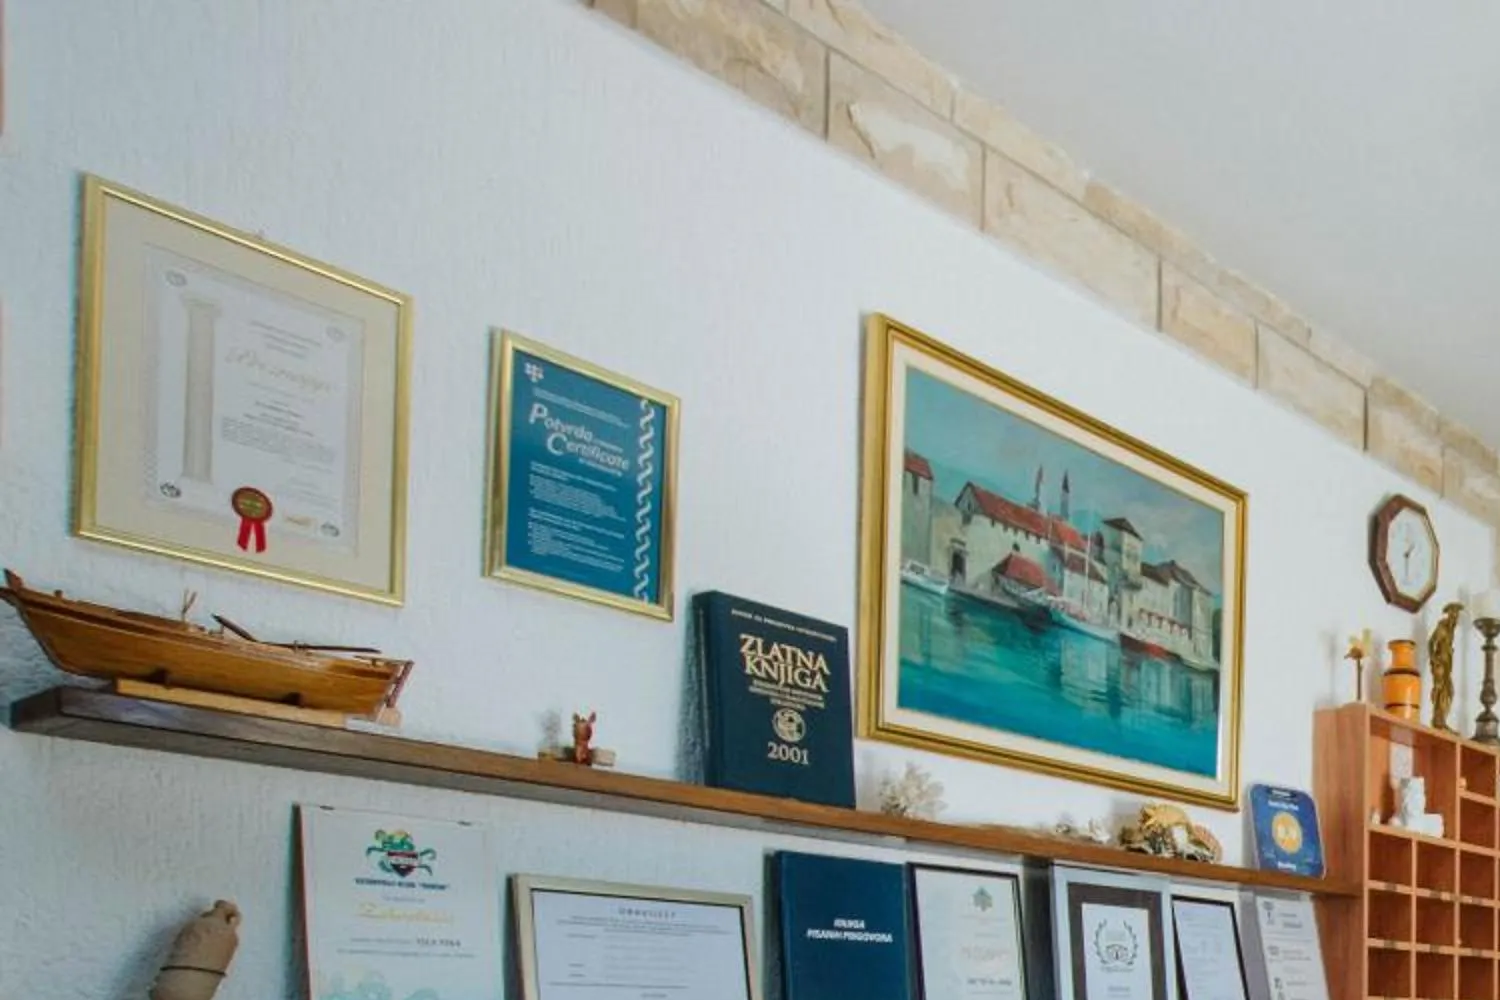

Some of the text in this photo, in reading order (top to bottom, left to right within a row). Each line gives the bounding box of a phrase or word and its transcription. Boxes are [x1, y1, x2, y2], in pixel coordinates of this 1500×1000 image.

[740, 633, 831, 676] ZLATNA
[745, 654, 831, 693] KNJIGA
[767, 741, 809, 765] 2001
